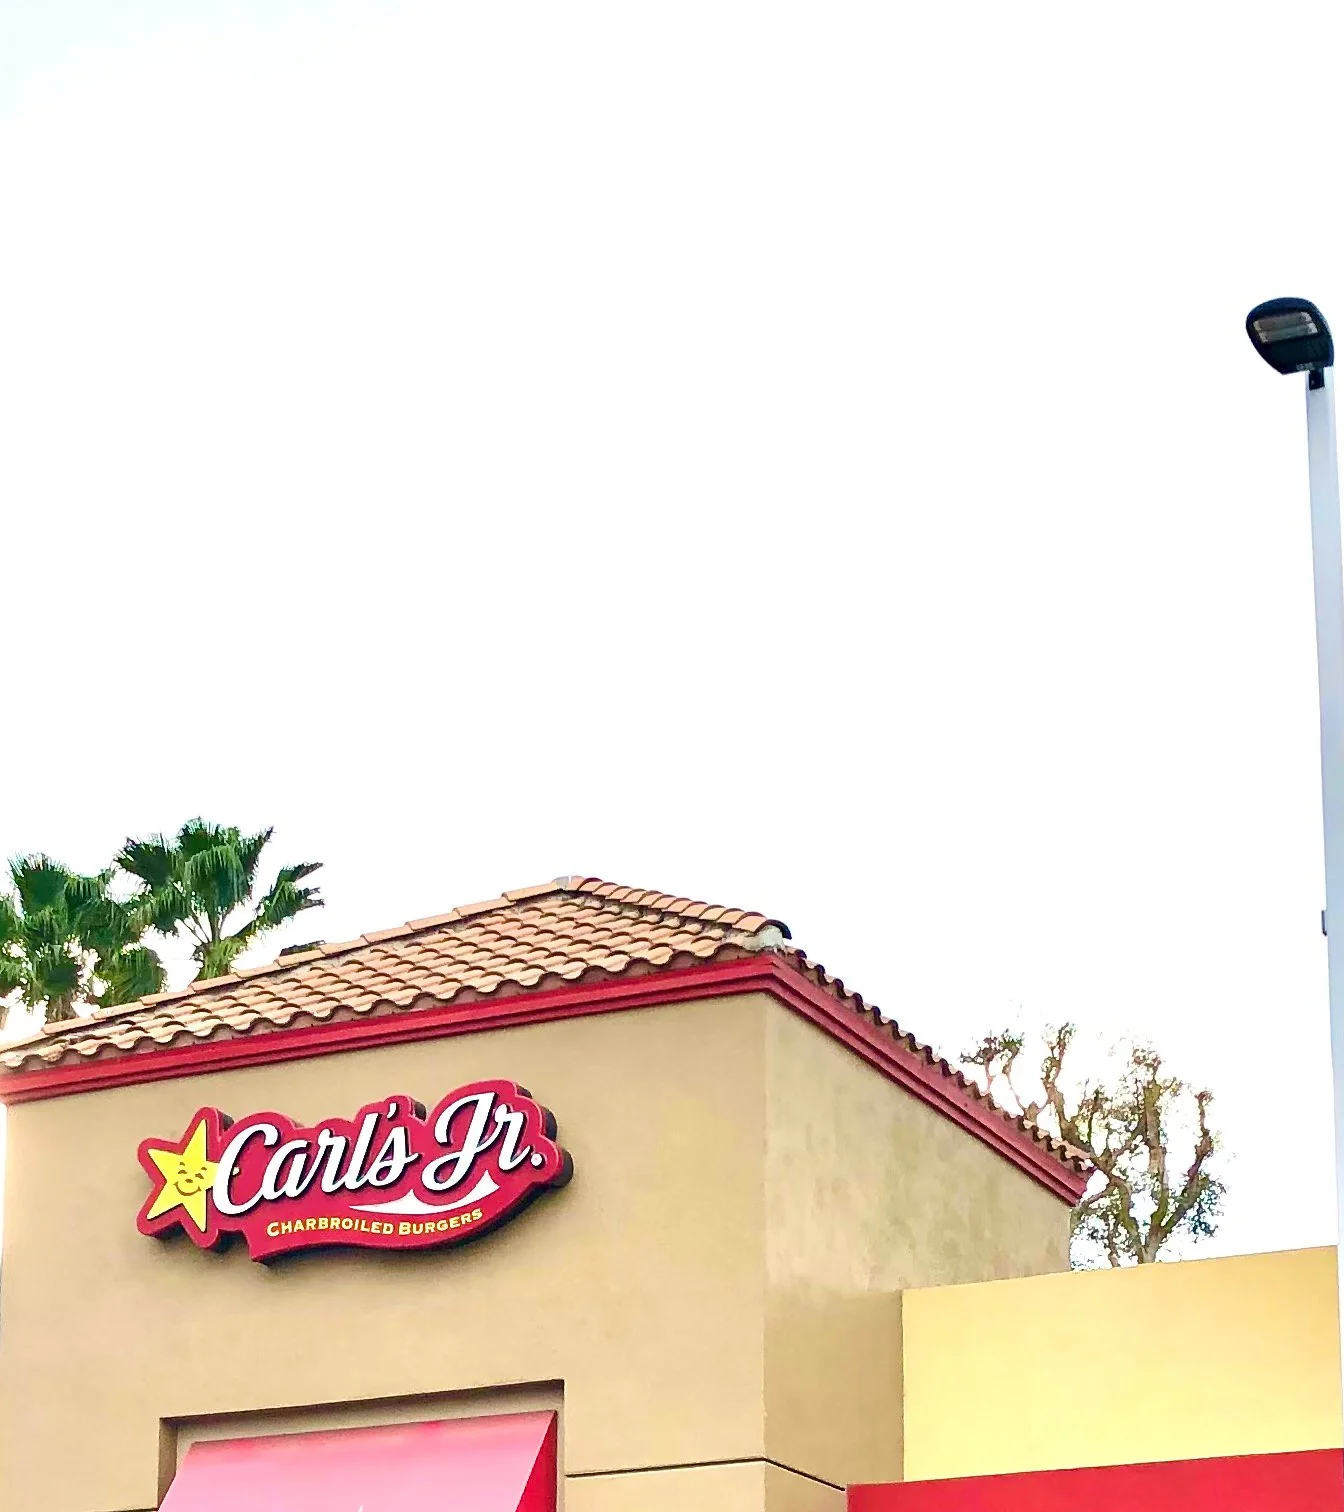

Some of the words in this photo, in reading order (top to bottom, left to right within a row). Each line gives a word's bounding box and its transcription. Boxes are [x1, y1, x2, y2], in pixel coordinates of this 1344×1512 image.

[212, 1102, 419, 1215] Carl's
[420, 1091, 544, 1192] Jr.
[266, 1215, 394, 1238] CHARBROILED
[399, 1208, 483, 1236] BURGERS
